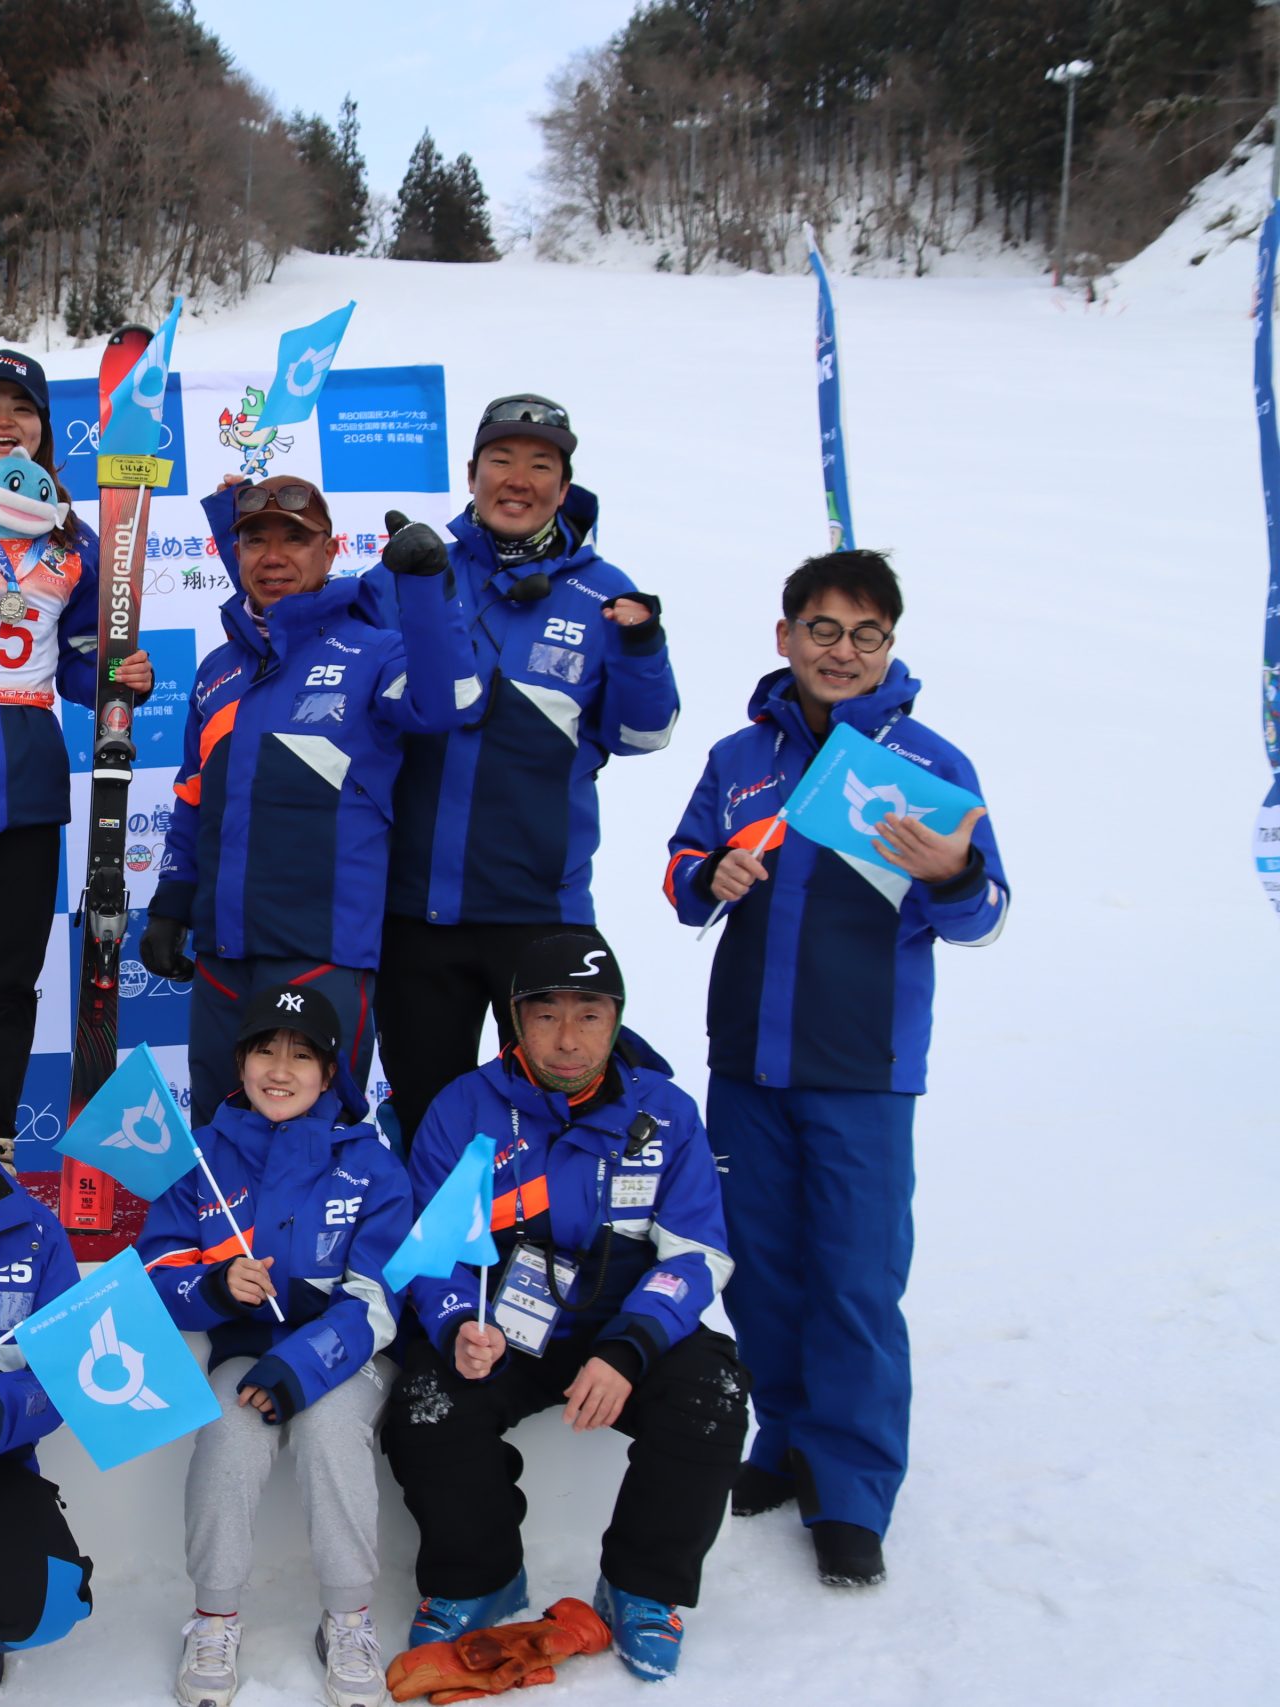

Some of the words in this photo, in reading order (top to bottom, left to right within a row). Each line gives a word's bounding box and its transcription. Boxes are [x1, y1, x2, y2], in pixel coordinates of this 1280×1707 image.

[110, 517, 134, 640] ROSSIGNOL
[543, 617, 587, 646] 25
[305, 664, 346, 687] 25
[511, 1108, 519, 1136] JAPAN
[79, 1178, 96, 1190] SL
[337, 1169, 370, 1187] ONYONE
[325, 1196, 363, 1225] 25
[438, 1302, 472, 1319] ONYONE
